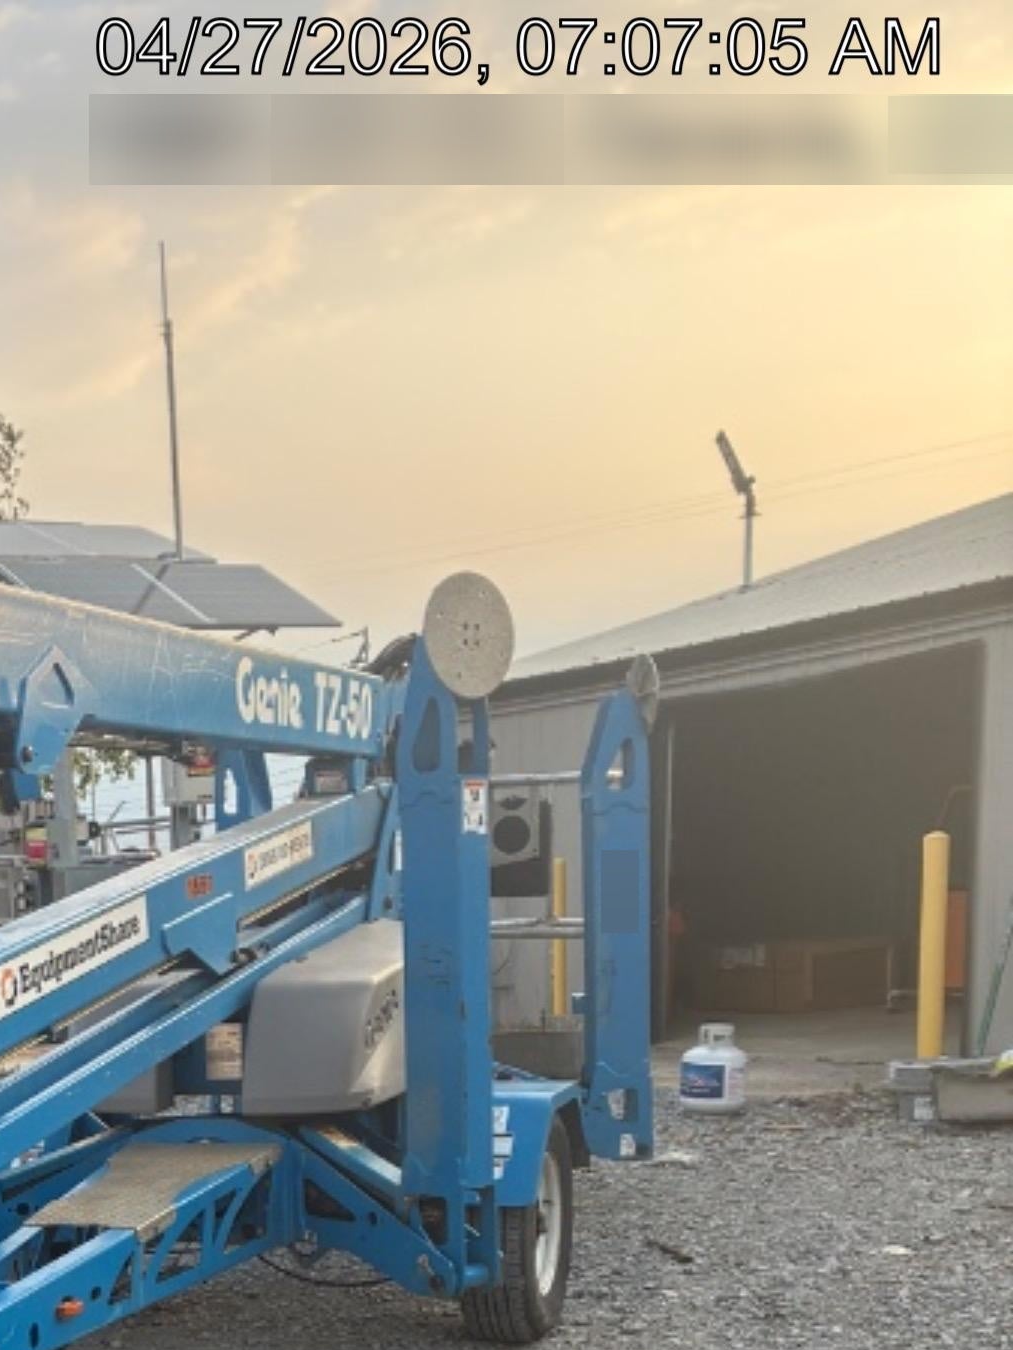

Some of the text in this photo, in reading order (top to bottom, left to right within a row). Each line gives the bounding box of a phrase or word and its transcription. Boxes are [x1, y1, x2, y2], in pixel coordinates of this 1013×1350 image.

[235, 656, 374, 740] Genie TZ-50
[18, 914, 141, 994] EquipmentShare
